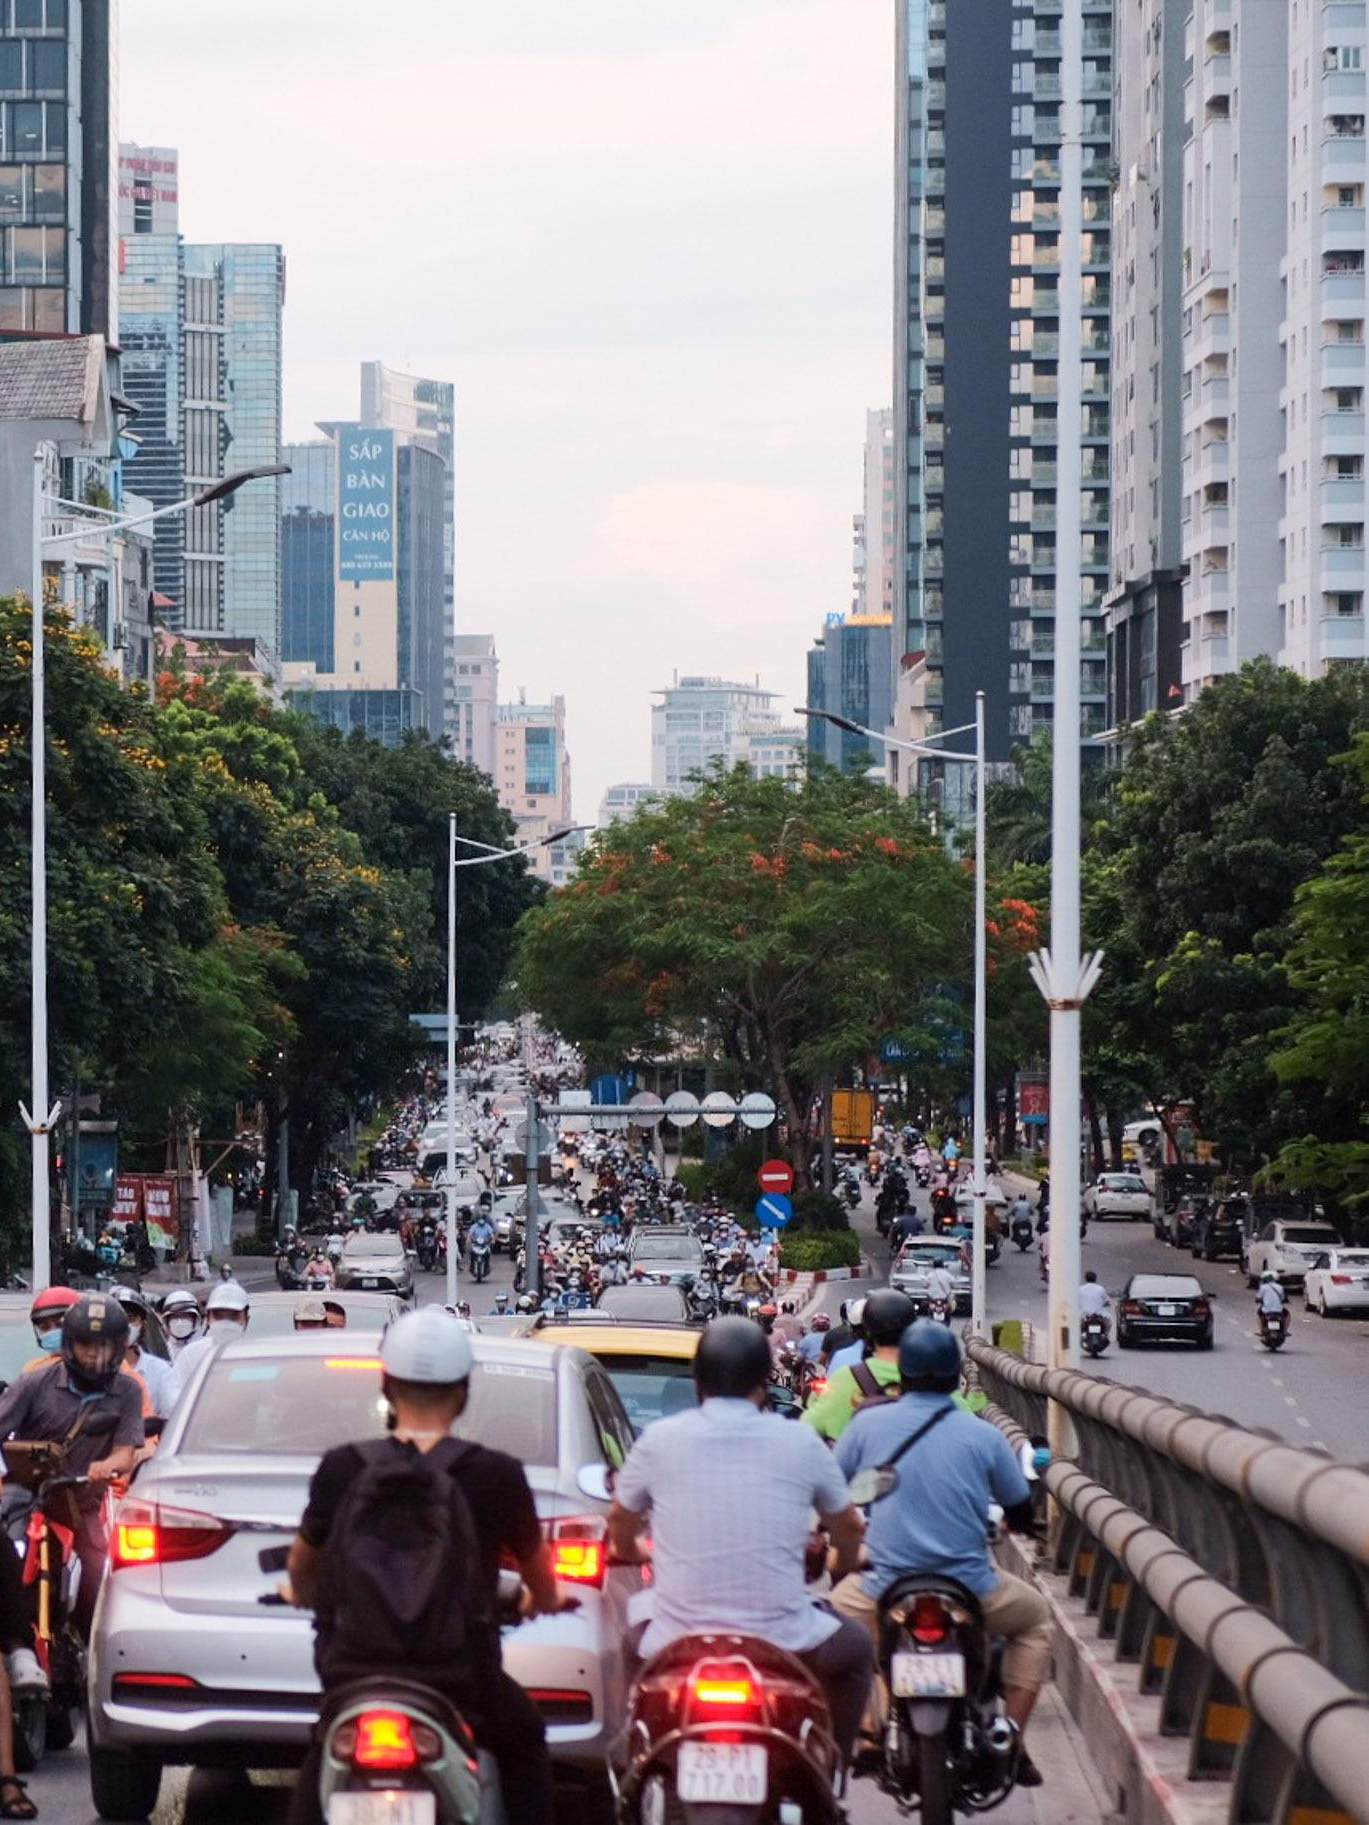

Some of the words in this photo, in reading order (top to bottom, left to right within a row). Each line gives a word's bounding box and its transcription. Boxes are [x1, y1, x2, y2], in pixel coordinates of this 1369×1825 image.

[349, 438, 382, 460] SẮP
[346, 469, 386, 489] BÀN
[343, 502, 390, 518] GIAO
[343, 528, 368, 541] CĂN
[371, 527, 390, 544] HỘ
